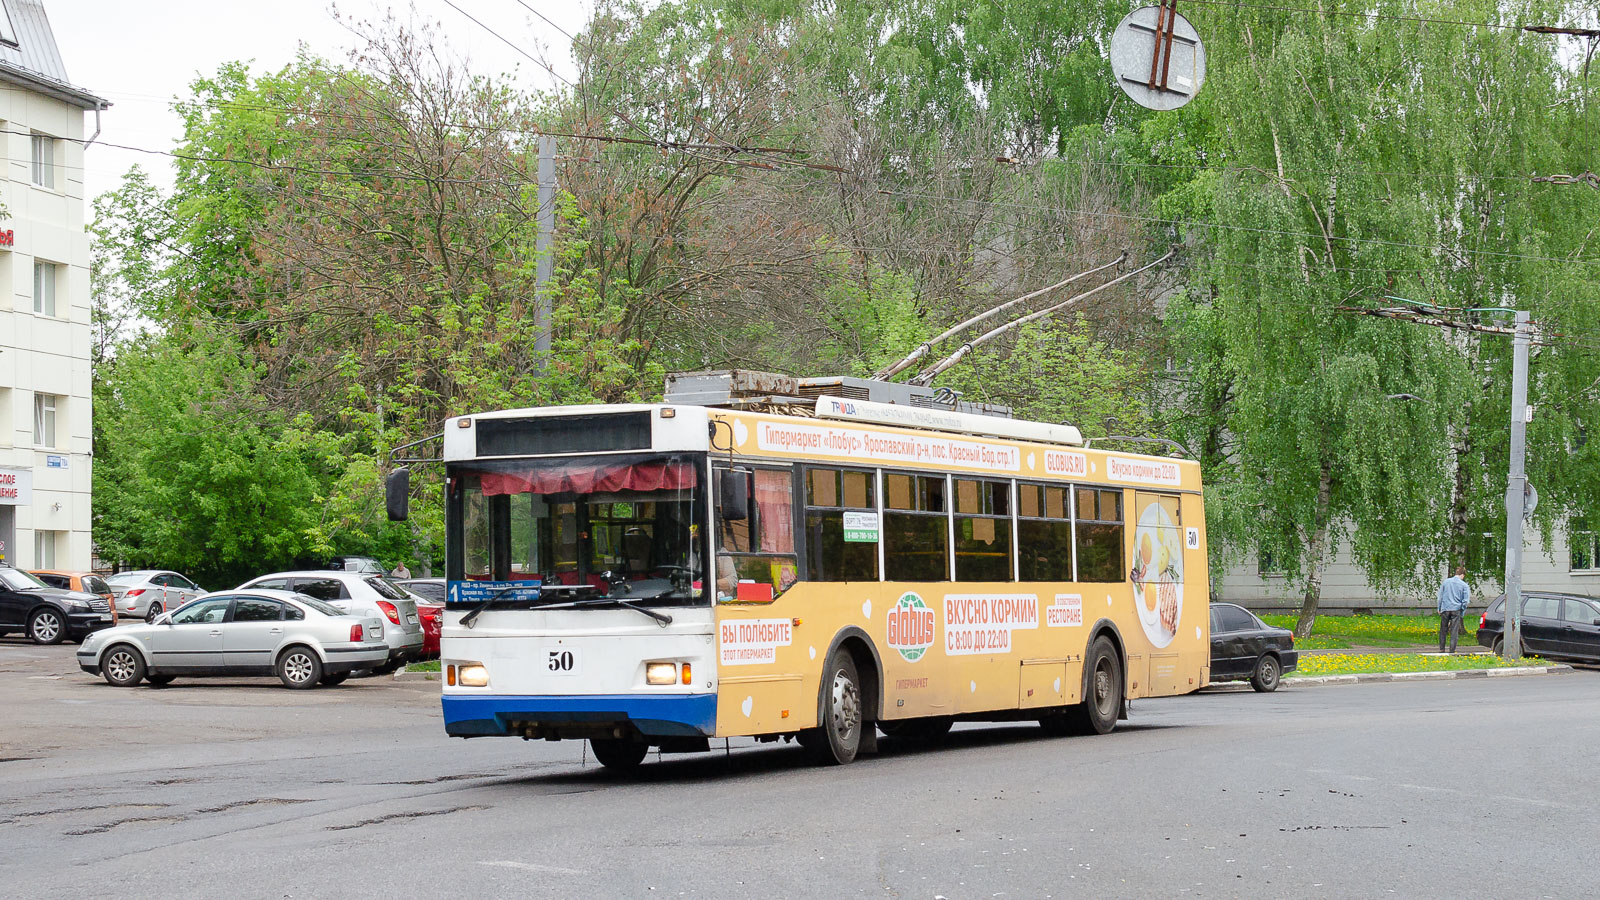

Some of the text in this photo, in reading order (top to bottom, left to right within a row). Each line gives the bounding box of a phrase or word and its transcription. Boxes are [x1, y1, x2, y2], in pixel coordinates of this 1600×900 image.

[765, 425, 821, 451] Гипермаркет
[823, 431, 862, 454] «Глобус»
[864, 434, 915, 456] Ярославский
[916, 442, 931, 460] р-н,
[932, 444, 948, 459] пос.
[948, 443, 980, 464] Красный
[1010, 449, 1015, 465] 1
[1047, 453, 1084, 474] GLOBUS.RU
[1111, 459, 1131, 478] Вкусно
[1132, 464, 1153, 480] кормим
[0, 487, 18, 498] ЕНИЕ
[1188, 531, 1197, 546] 50
[450, 584, 458, 602] 1
[946, 599, 1037, 625] ВКУСНО КОРМИМ
[1048, 608, 1081, 624] РЕСТОРАНЕ
[722, 623, 789, 643] ВЫ ПОЛЮБИТЕ
[948, 629, 1008, 652] С 8:00 ДО 22:00
[548, 651, 574, 671] 50
[723, 647, 773, 660] ЭТОТ ГИПЕРМАРКЕТ
